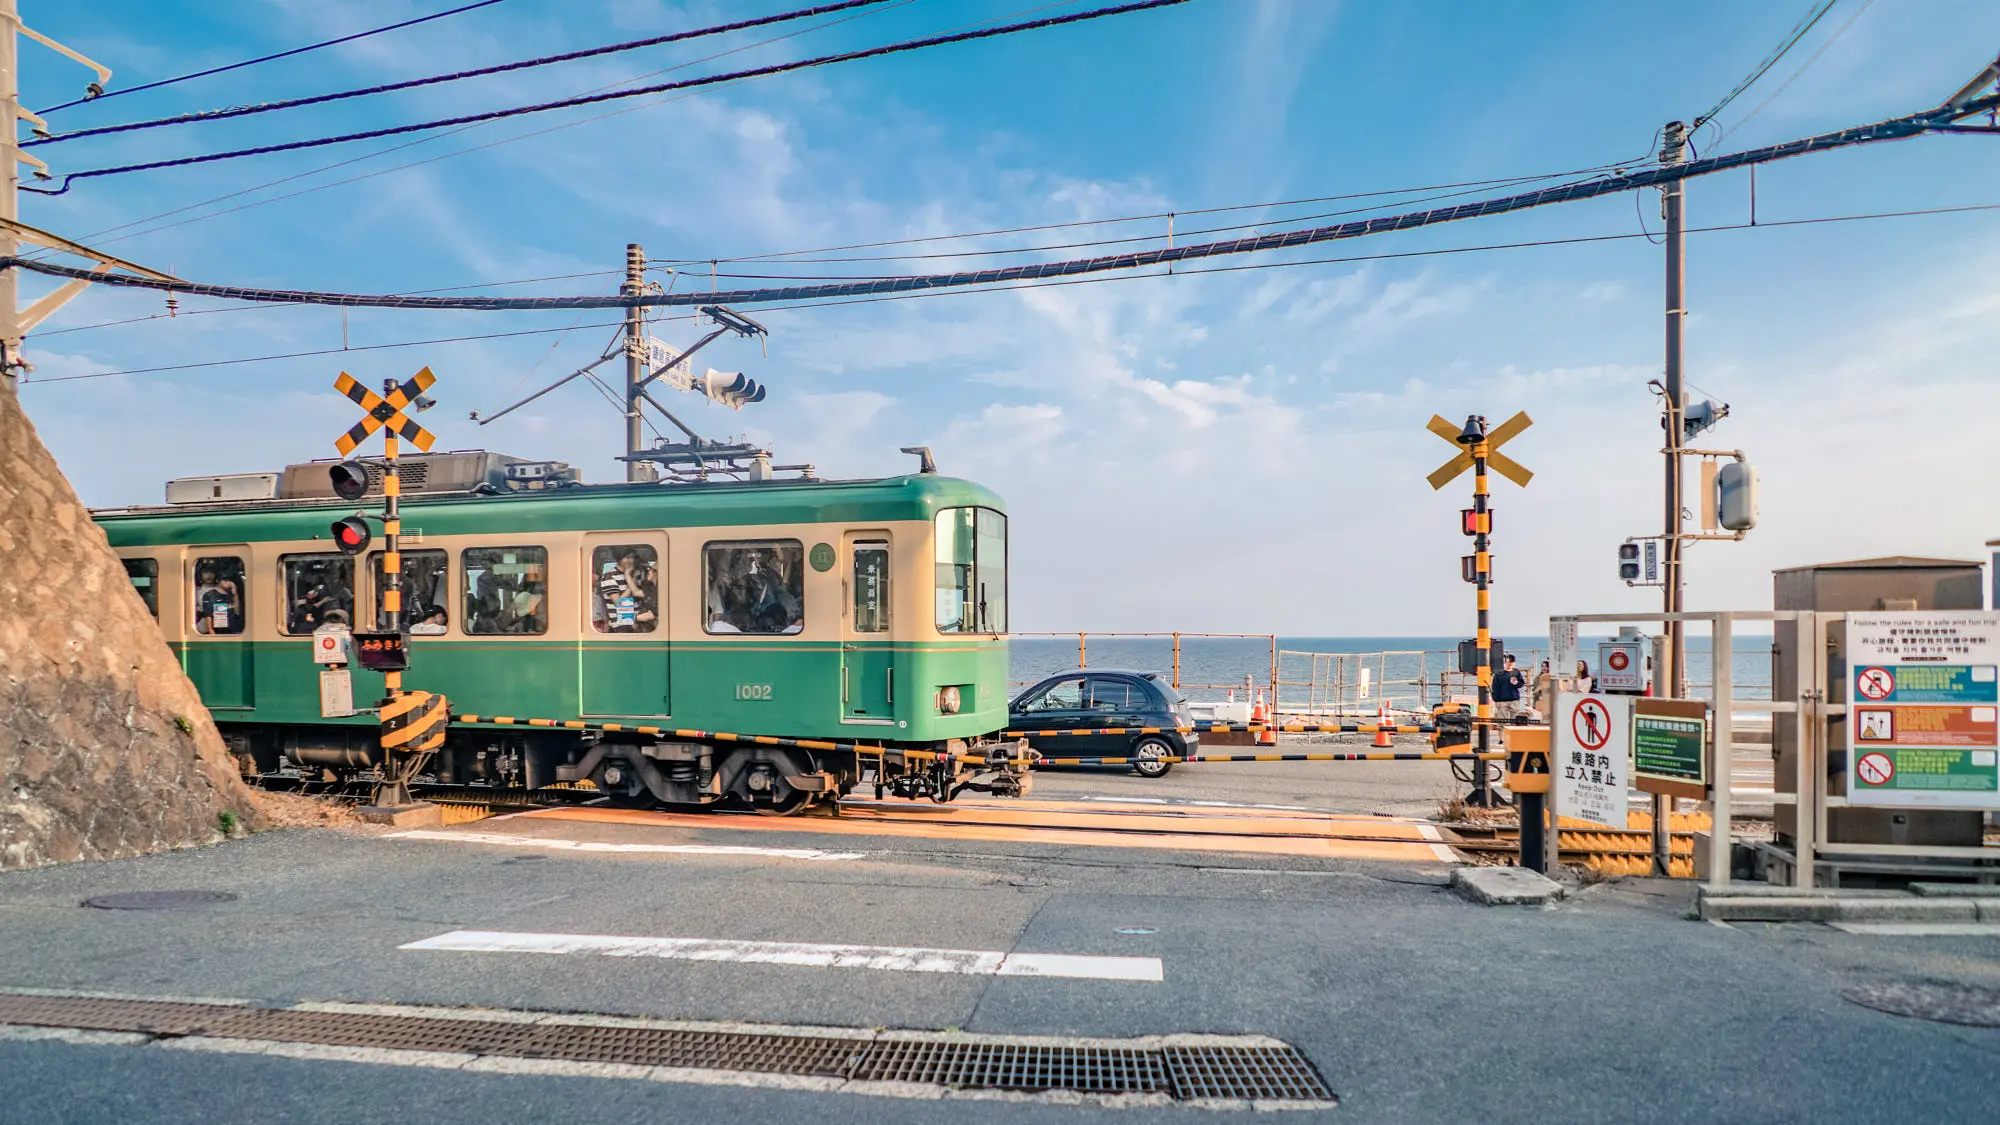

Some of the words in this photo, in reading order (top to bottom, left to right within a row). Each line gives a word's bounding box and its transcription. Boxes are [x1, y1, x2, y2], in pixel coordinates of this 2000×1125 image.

[735, 684, 772, 700] 1002
[1571, 751, 1609, 769] 線路内
[1565, 765, 1616, 787] 立入禁止
